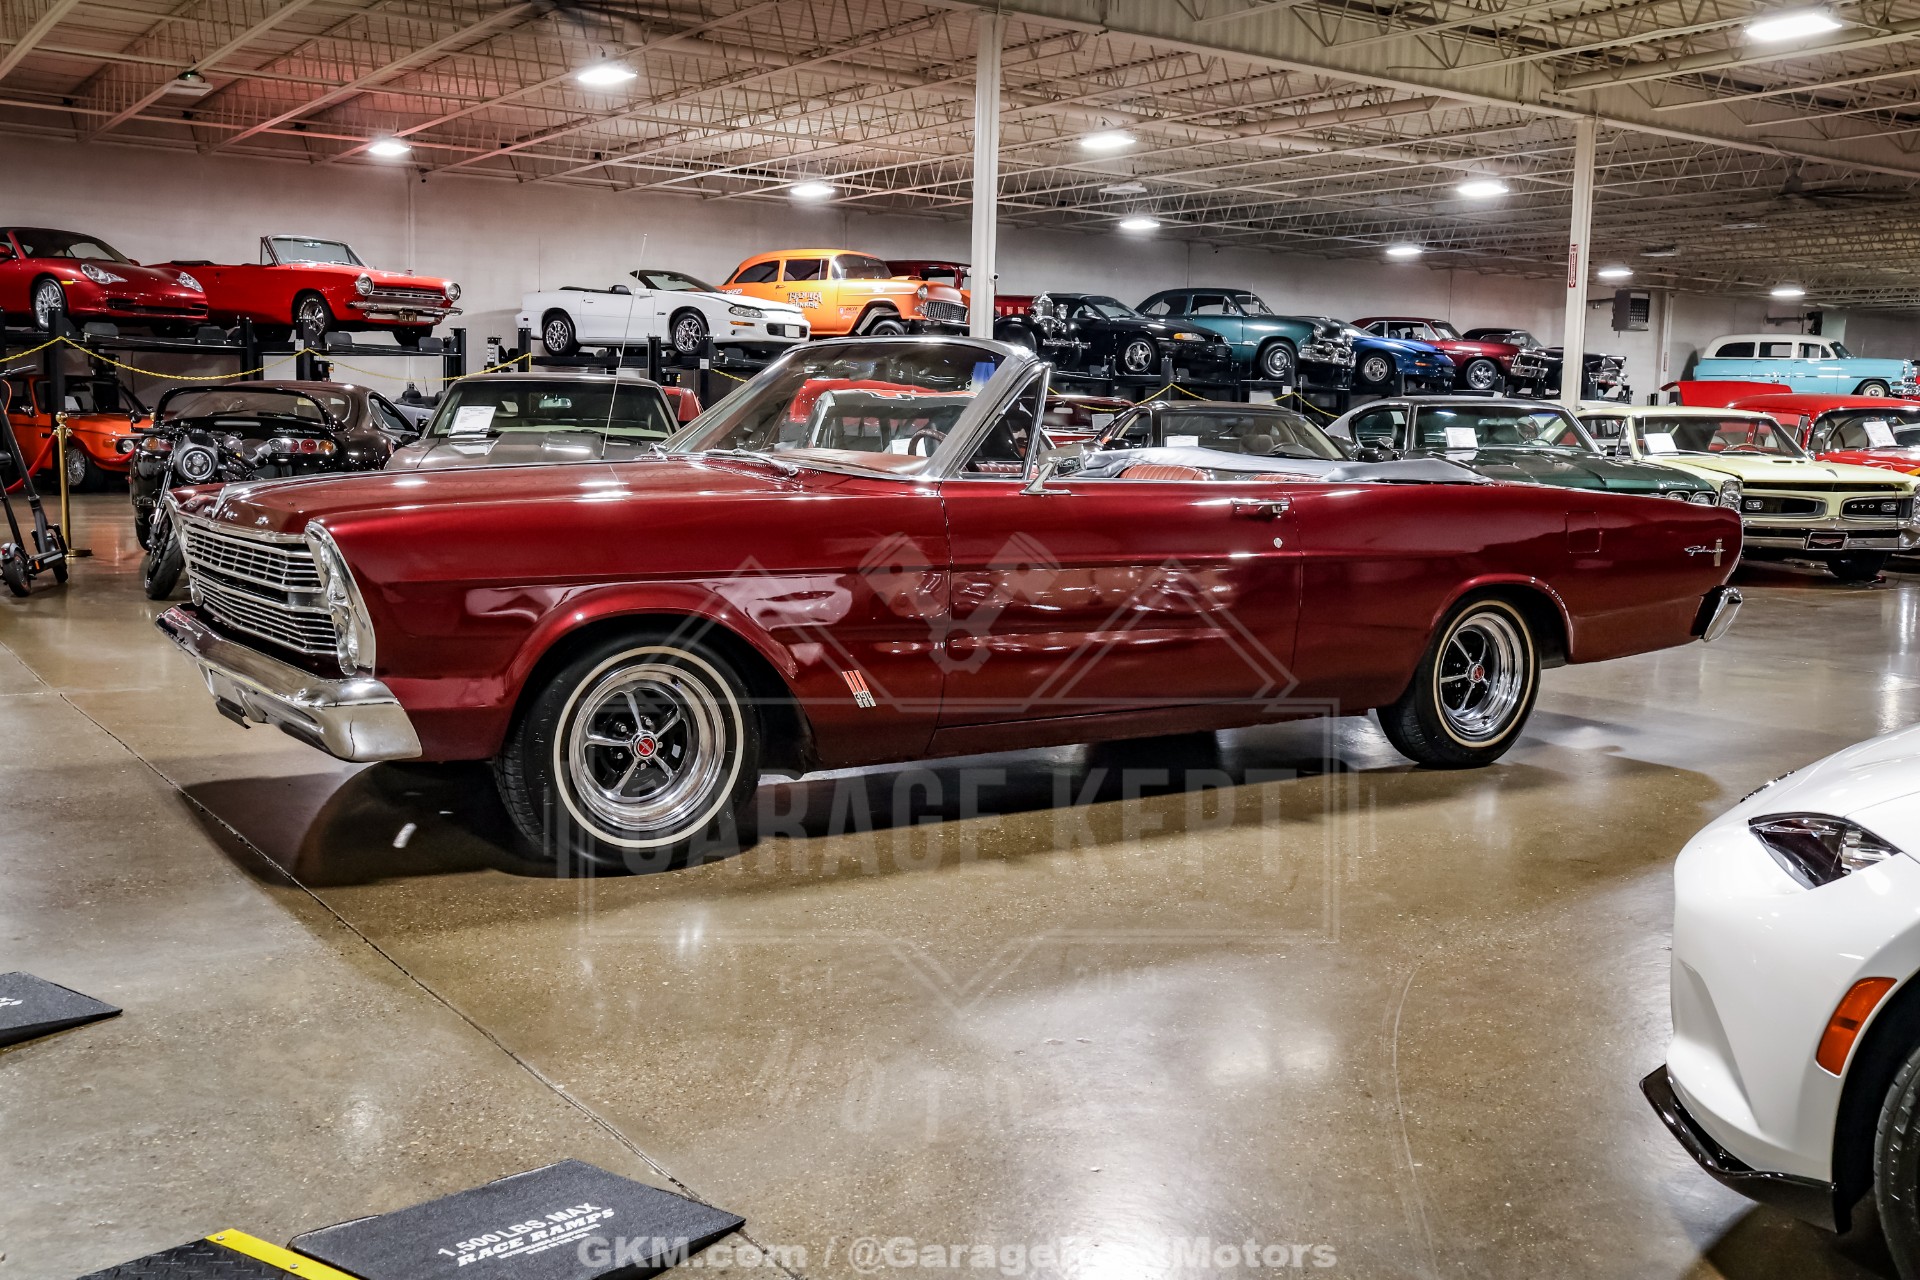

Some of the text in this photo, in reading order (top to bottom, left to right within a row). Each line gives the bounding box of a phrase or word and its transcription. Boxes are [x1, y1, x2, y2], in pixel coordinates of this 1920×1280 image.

[545, 1202, 602, 1223] MAX
[456, 1237, 525, 1267] RACE
[530, 1208, 615, 1242] RAMPS
